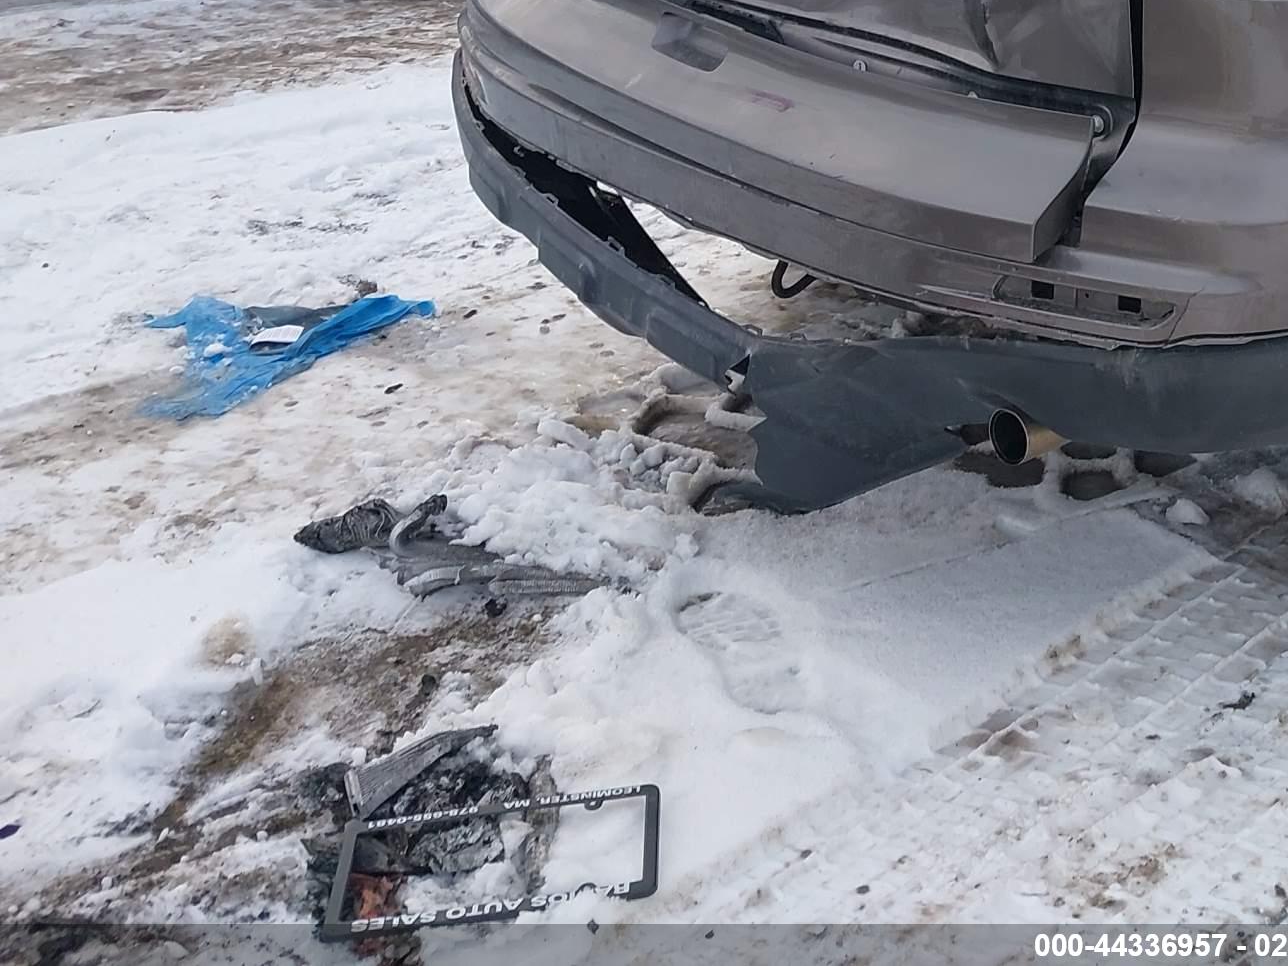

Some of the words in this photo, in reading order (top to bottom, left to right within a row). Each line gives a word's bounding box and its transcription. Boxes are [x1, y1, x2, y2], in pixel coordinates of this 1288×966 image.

[503, 799, 531, 810] MA
[446, 897, 523, 920] AUTO
[350, 911, 436, 933] SALES
